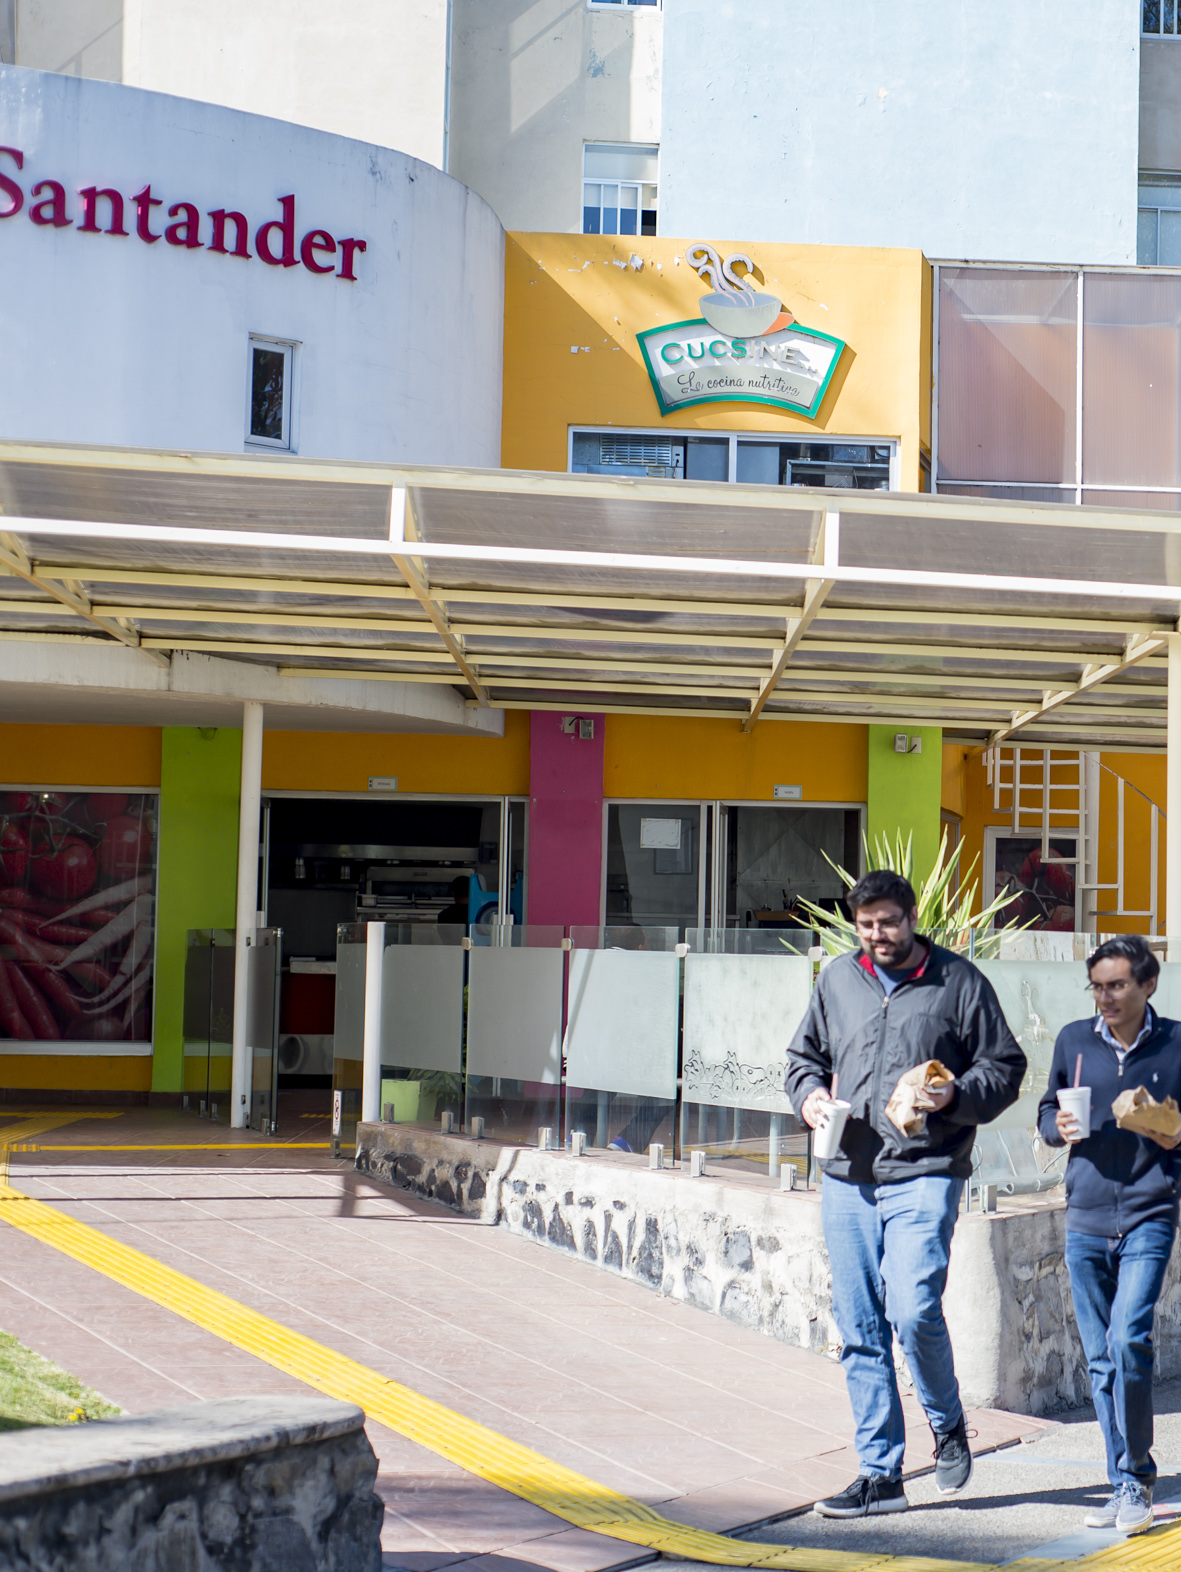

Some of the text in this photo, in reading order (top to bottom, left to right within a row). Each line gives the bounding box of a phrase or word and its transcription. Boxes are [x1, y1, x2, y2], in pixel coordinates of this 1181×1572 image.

[0, 146, 367, 281] Santander
[677, 371, 800, 397] La cocina nutritiva
